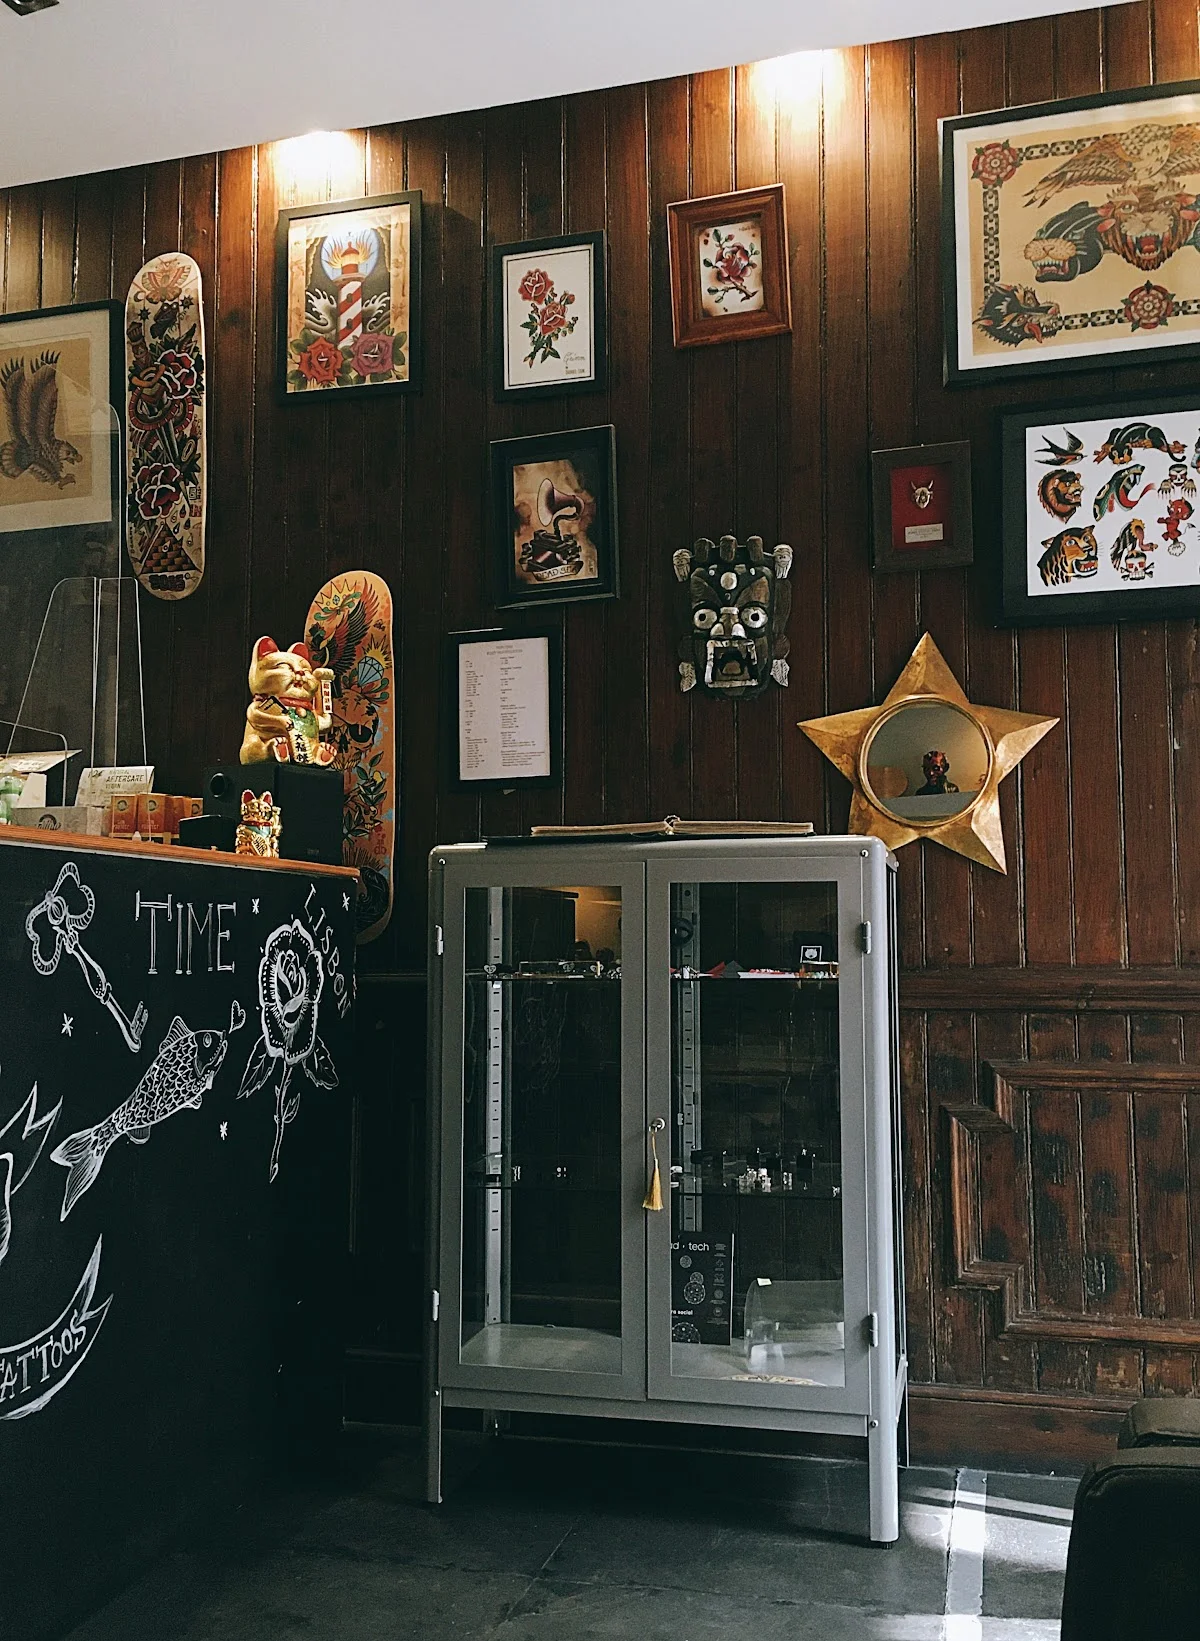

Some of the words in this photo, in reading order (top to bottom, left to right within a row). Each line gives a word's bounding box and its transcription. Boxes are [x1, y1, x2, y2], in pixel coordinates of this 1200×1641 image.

[105, 774, 145, 783] AFTERCARE
[135, 890, 237, 975] TIME
[304, 883, 351, 1019] LISBON
[688, 1242, 710, 1251] tech
